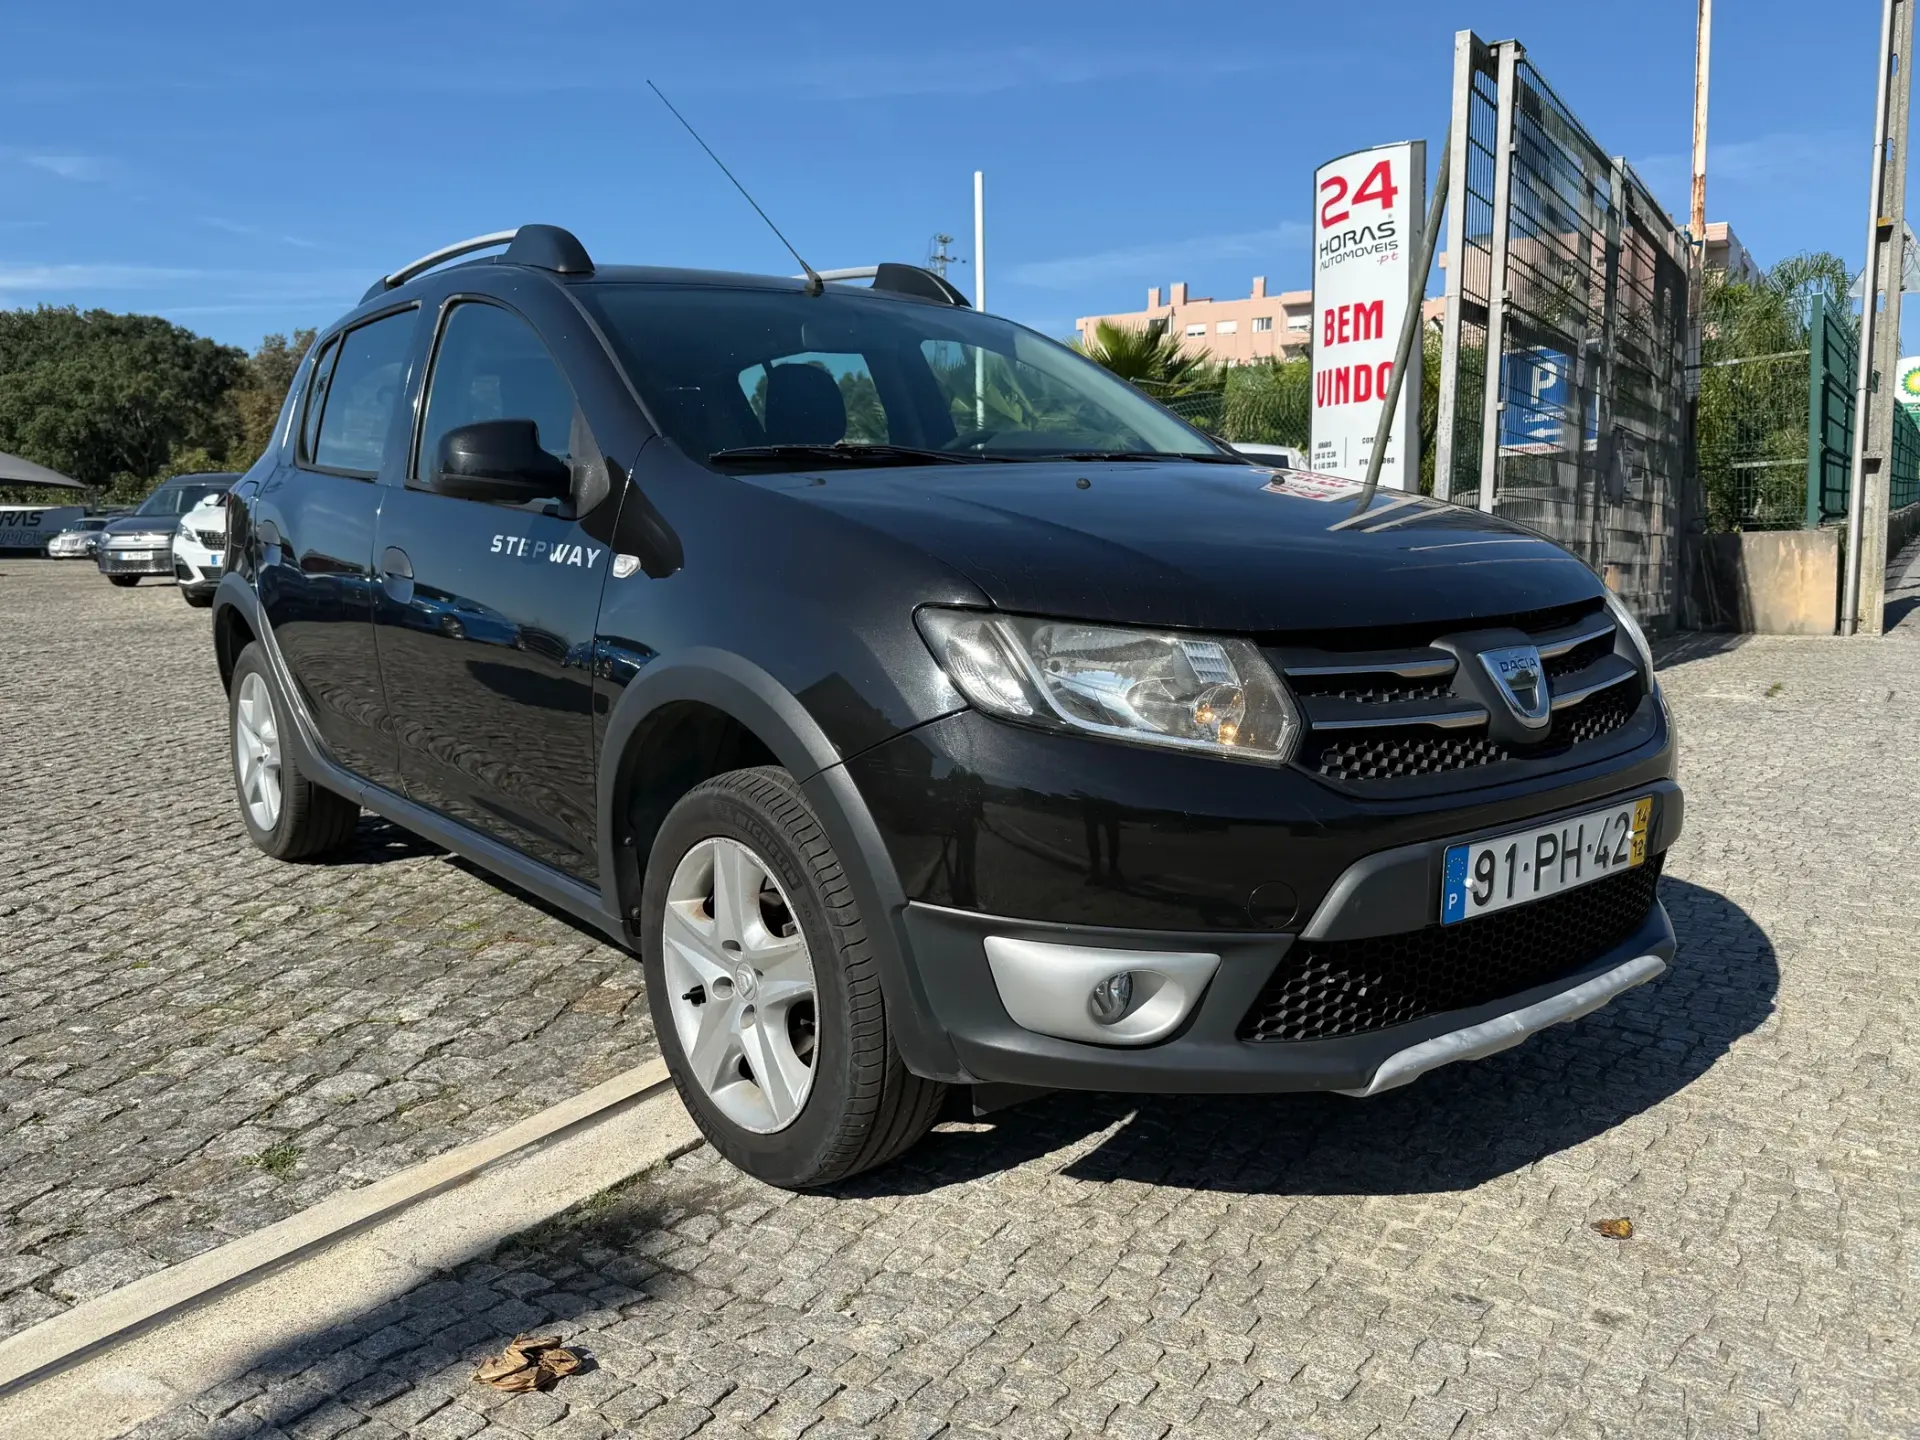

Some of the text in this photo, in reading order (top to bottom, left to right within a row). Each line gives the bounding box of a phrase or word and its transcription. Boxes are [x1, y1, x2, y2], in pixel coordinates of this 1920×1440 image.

[1320, 159, 1398, 229] 24
[1319, 220, 1396, 260] HORAS
[1319, 240, 1398, 272] AUTOMOVEIS
[1323, 299, 1384, 348] BEM
[490, 534, 602, 568] STEPWAY
[1500, 656, 1539, 674] DACIA
[1635, 806, 1647, 825] 14
[1632, 839, 1644, 858] 12
[1448, 893, 1458, 910] P
